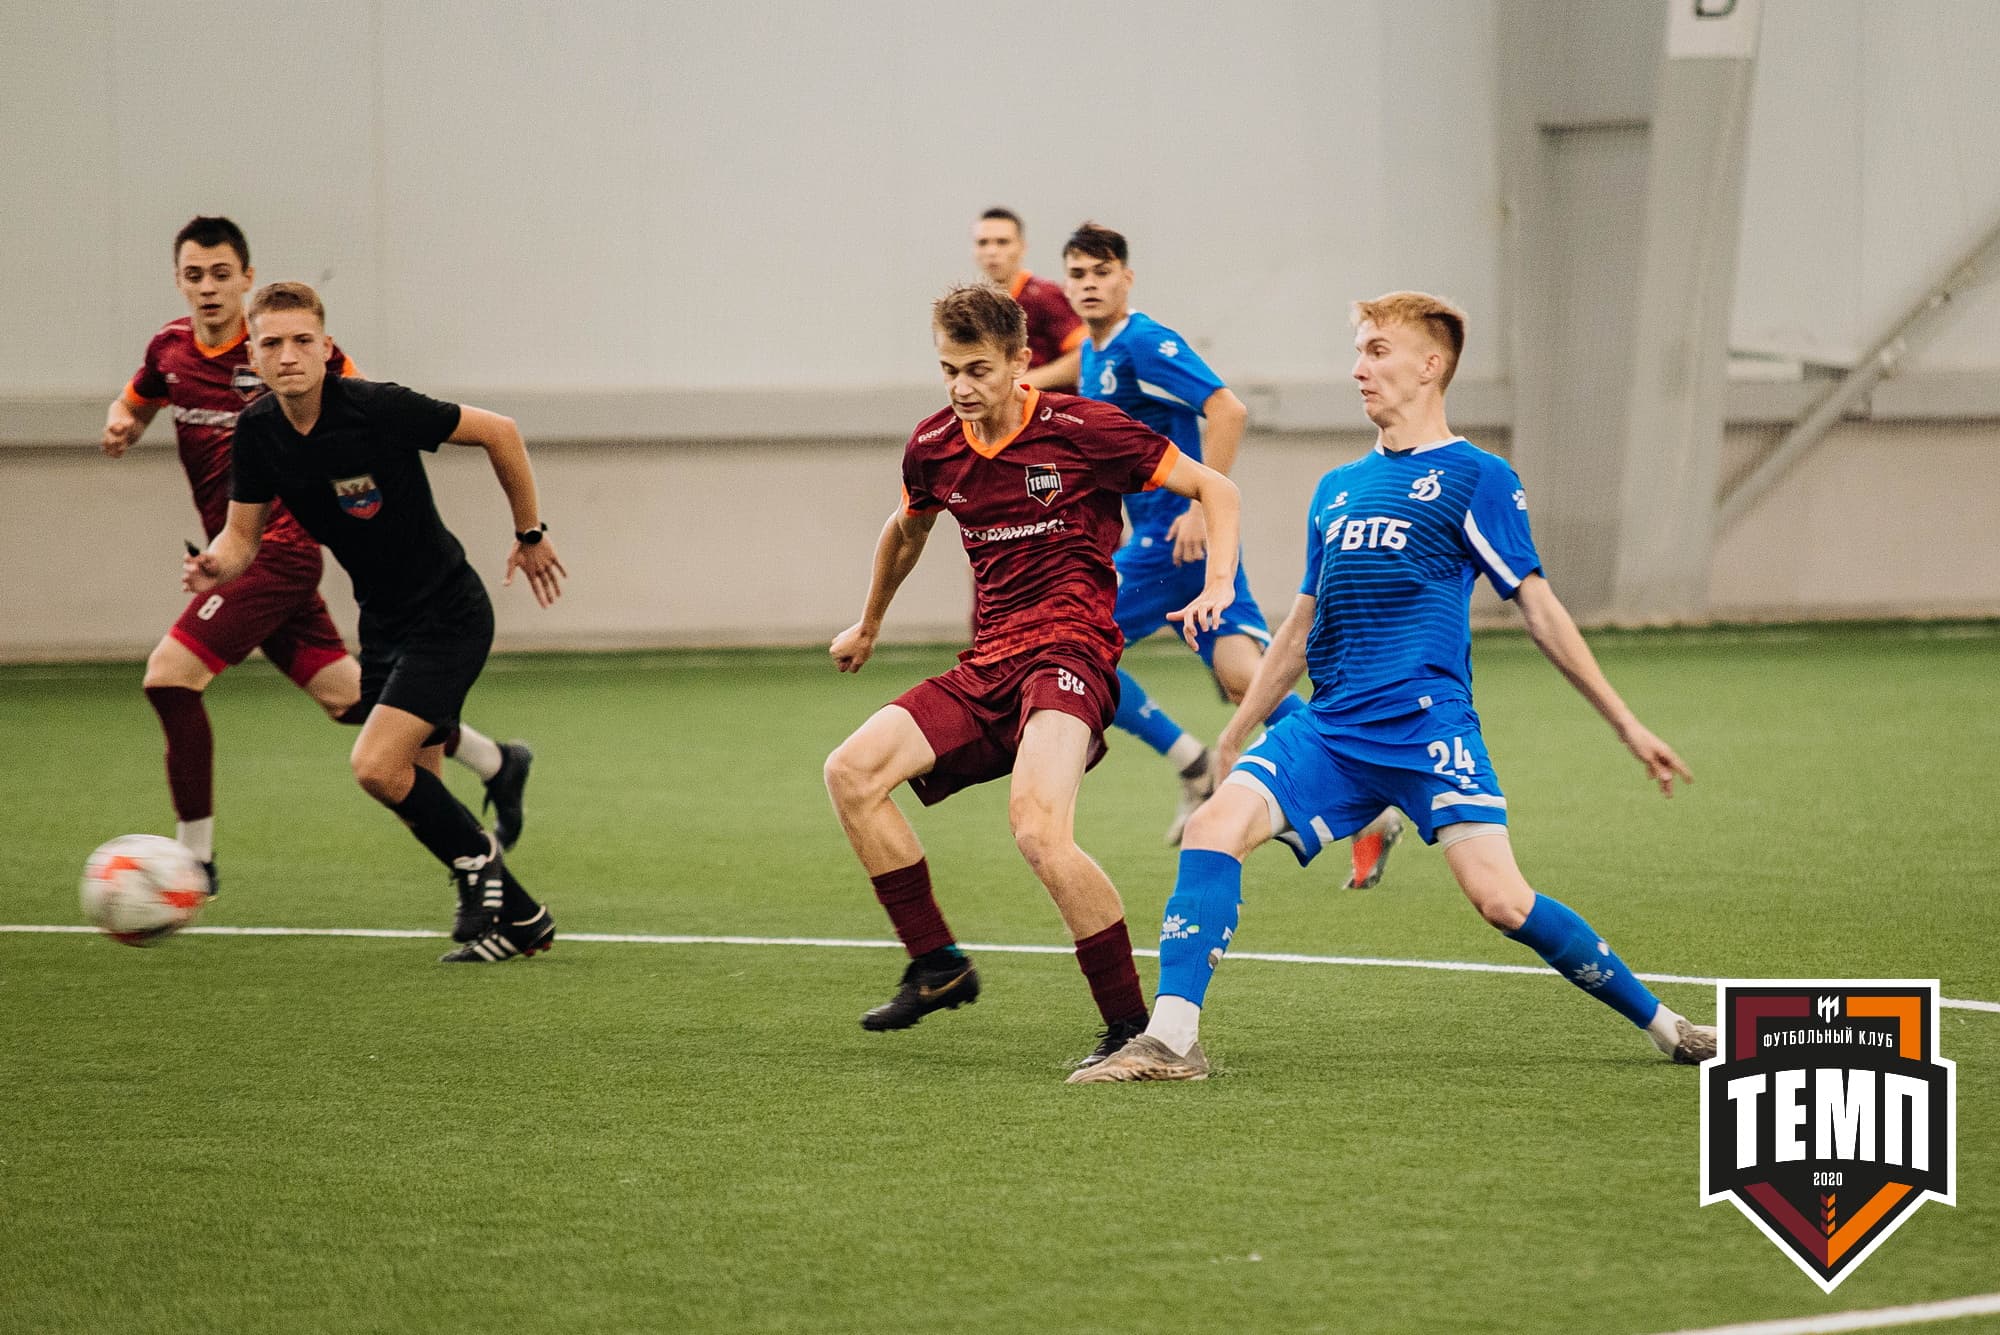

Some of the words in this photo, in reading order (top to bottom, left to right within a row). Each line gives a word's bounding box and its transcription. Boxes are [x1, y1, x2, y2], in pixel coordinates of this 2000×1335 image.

[1341, 516, 1412, 550] ВТБ
[197, 594, 224, 620] 8
[1427, 736, 1475, 775] 24
